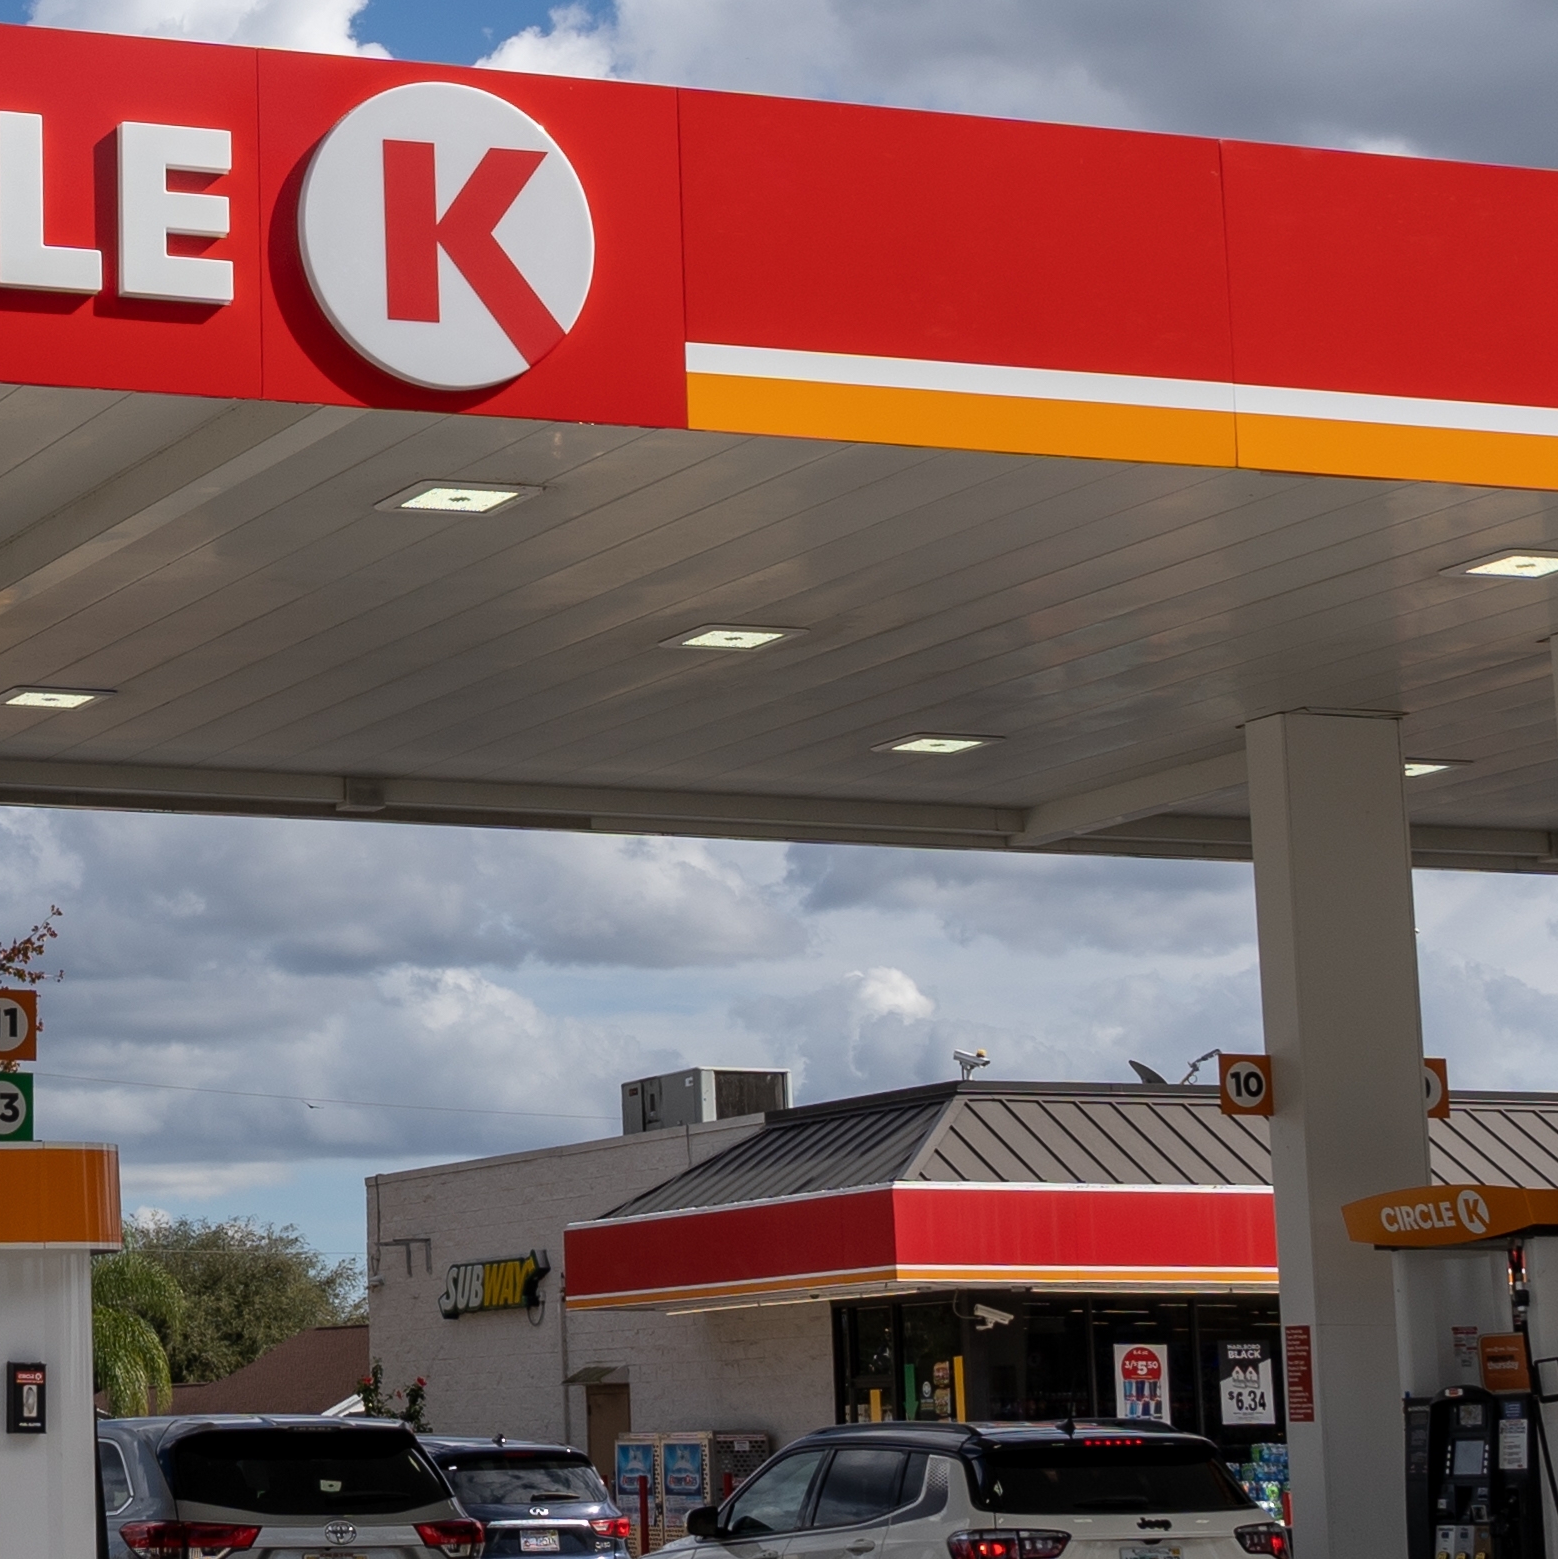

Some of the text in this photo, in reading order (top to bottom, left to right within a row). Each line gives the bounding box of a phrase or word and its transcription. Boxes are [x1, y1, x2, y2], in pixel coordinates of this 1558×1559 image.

[1230, 1071, 1263, 1097] 10
[1380, 1201, 1456, 1232] CIRCLE
[440, 1255, 536, 1312] SUBWAY
[1227, 1350, 1261, 1359] BLACK
[1227, 1390, 1267, 1412] $6.34
